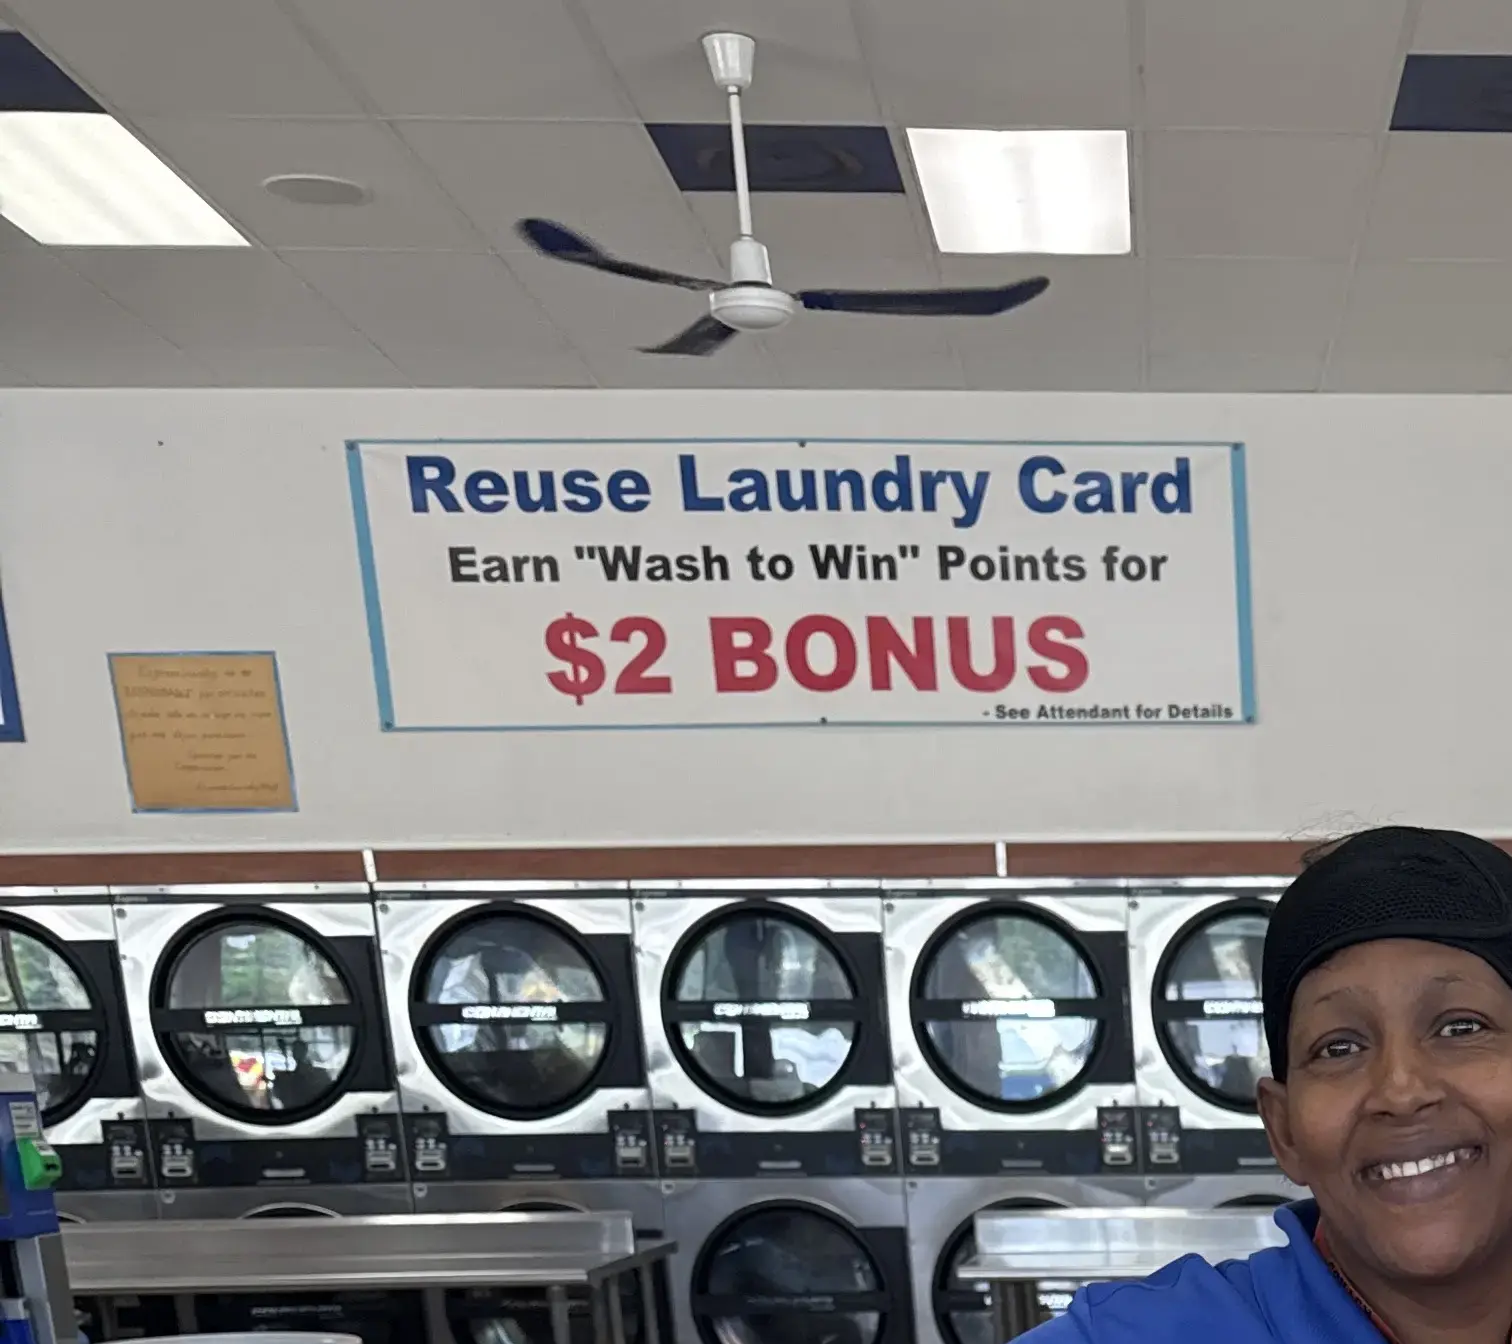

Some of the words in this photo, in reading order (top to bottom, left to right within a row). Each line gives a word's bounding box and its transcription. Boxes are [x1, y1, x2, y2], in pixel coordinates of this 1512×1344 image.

[405, 454, 651, 514] Reuse
[678, 454, 991, 529] Laundry
[1018, 455, 1193, 514] Card
[448, 546, 560, 583] Earn
[574, 545, 730, 582] "Wash
[746, 545, 794, 581] to
[809, 544, 920, 581] Win"
[938, 545, 1086, 582] Points
[1101, 545, 1169, 581] for
[544, 612, 673, 706] $2
[709, 614, 1090, 694] BONUS
[995, 704, 1030, 720] See
[1036, 704, 1130, 720] Attendant
[1135, 704, 1162, 720] for
[1168, 704, 1233, 720] Details
